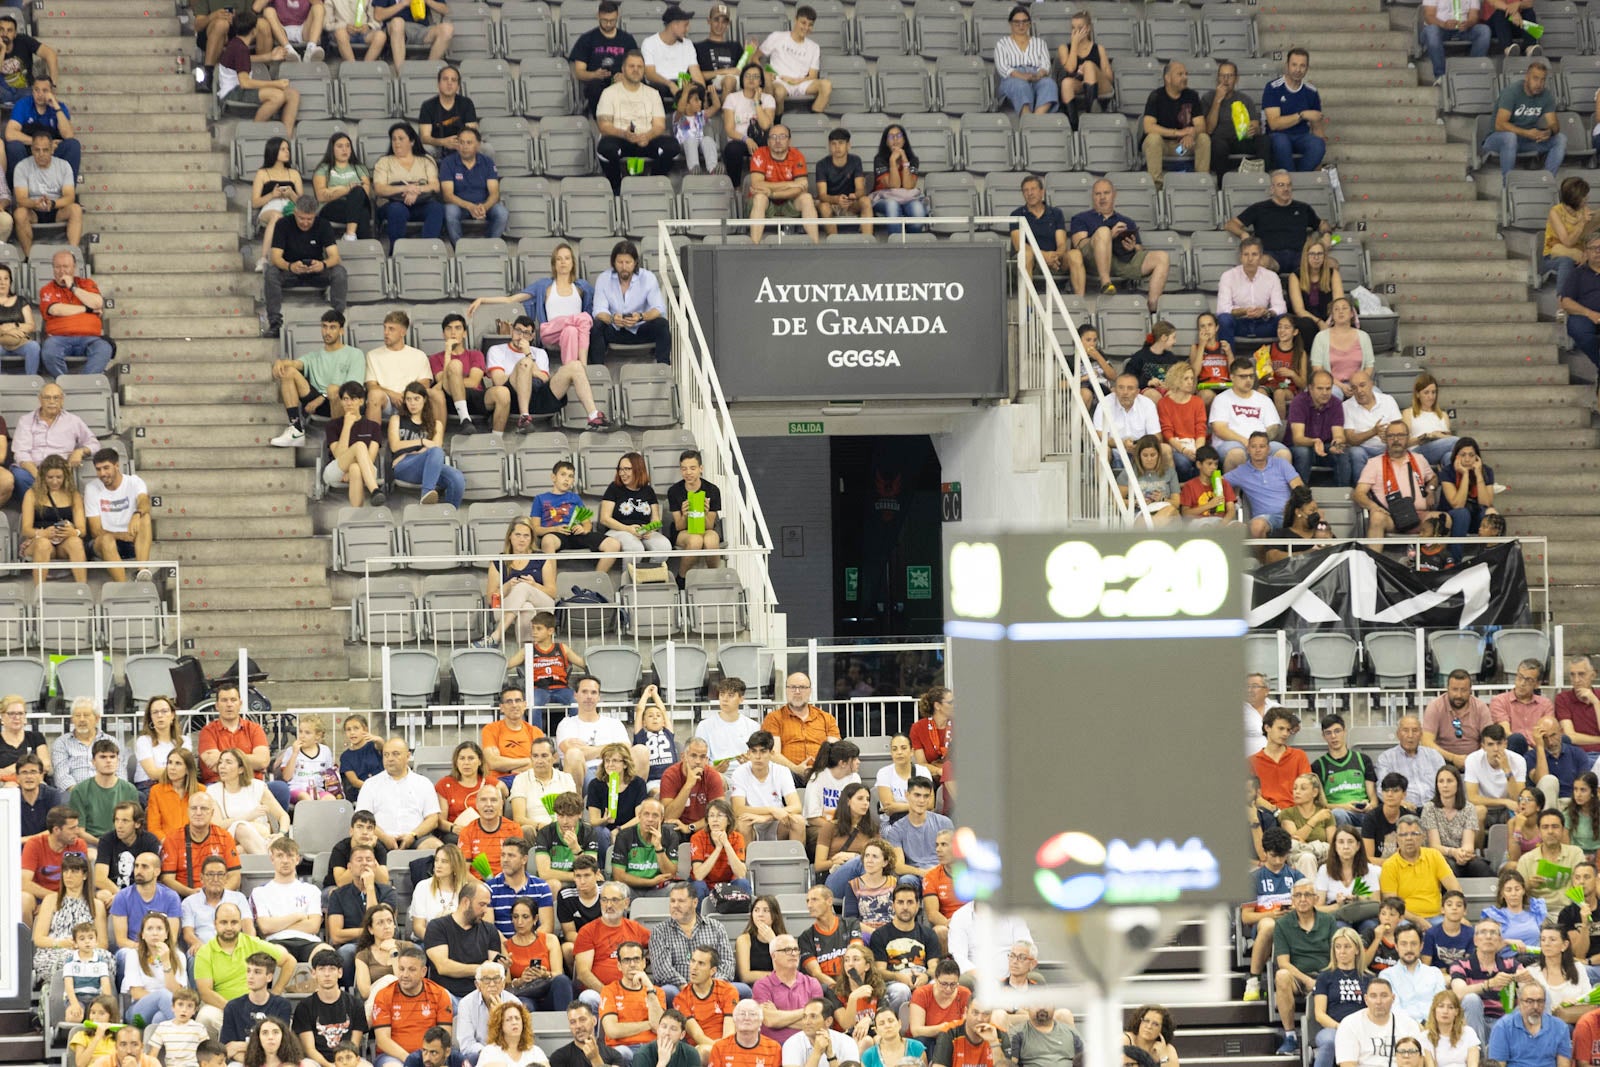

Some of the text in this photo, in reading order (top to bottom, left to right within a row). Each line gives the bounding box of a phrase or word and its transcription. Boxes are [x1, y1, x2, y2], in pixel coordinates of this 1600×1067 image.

[754, 276, 965, 303] AYUNTAMIENTO
[1387, 285, 1395, 293] 6
[106, 299, 113, 308] 6
[771, 308, 948, 336] DE GRANADA
[790, 423, 822, 433] SALIDA
[152, 496, 160, 506] 3
[1045, 538, 1229, 619] 9:20
[646, 734, 673, 761] 82
[1261, 879, 1275, 892] 15
